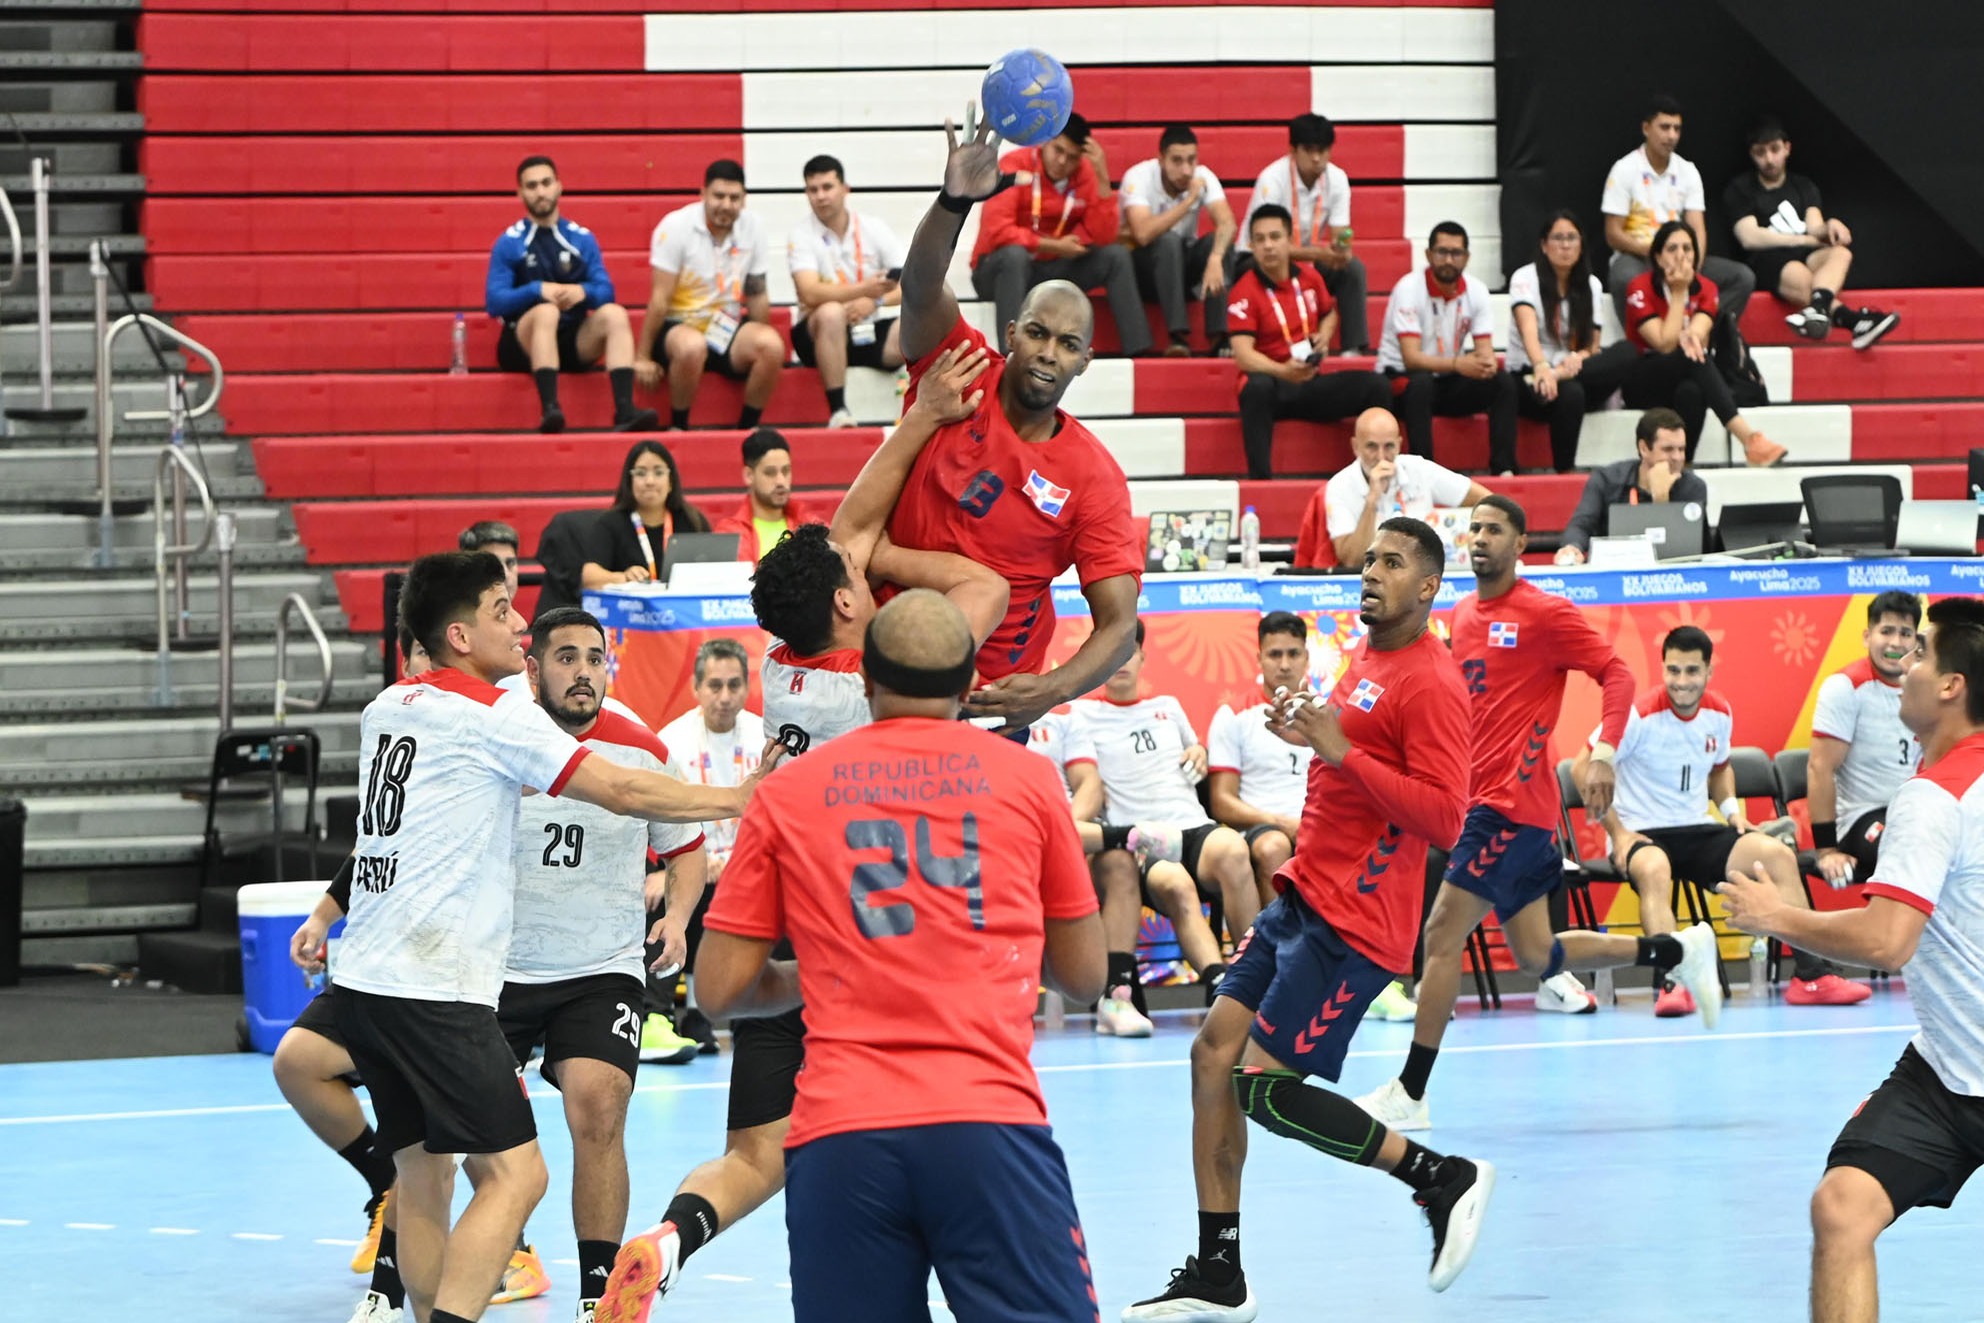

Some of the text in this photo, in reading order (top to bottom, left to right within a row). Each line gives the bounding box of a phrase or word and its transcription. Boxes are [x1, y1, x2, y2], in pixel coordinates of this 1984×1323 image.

[1641, 573, 1685, 585] JUEGOS
[1729, 567, 1789, 584] Ayacucho
[1847, 574, 1931, 587] BOLIVARIANOS
[1865, 564, 1909, 576] JUEGOS
[1180, 592, 1264, 605] BOLIVARIANOS
[1281, 583, 1343, 598] Ayacucho
[1623, 581, 1708, 597] BOLIVARIANOS
[1129, 729, 1157, 753] 28
[1898, 738, 1909, 766] 3
[832, 753, 982, 783] REPUBLICA
[1680, 764, 1691, 792] 11
[363, 733, 417, 838] 18
[824, 777, 992, 808] DOMINICANA
[542, 823, 585, 868] 29
[845, 811, 986, 940] 24
[611, 1002, 641, 1049] 29
